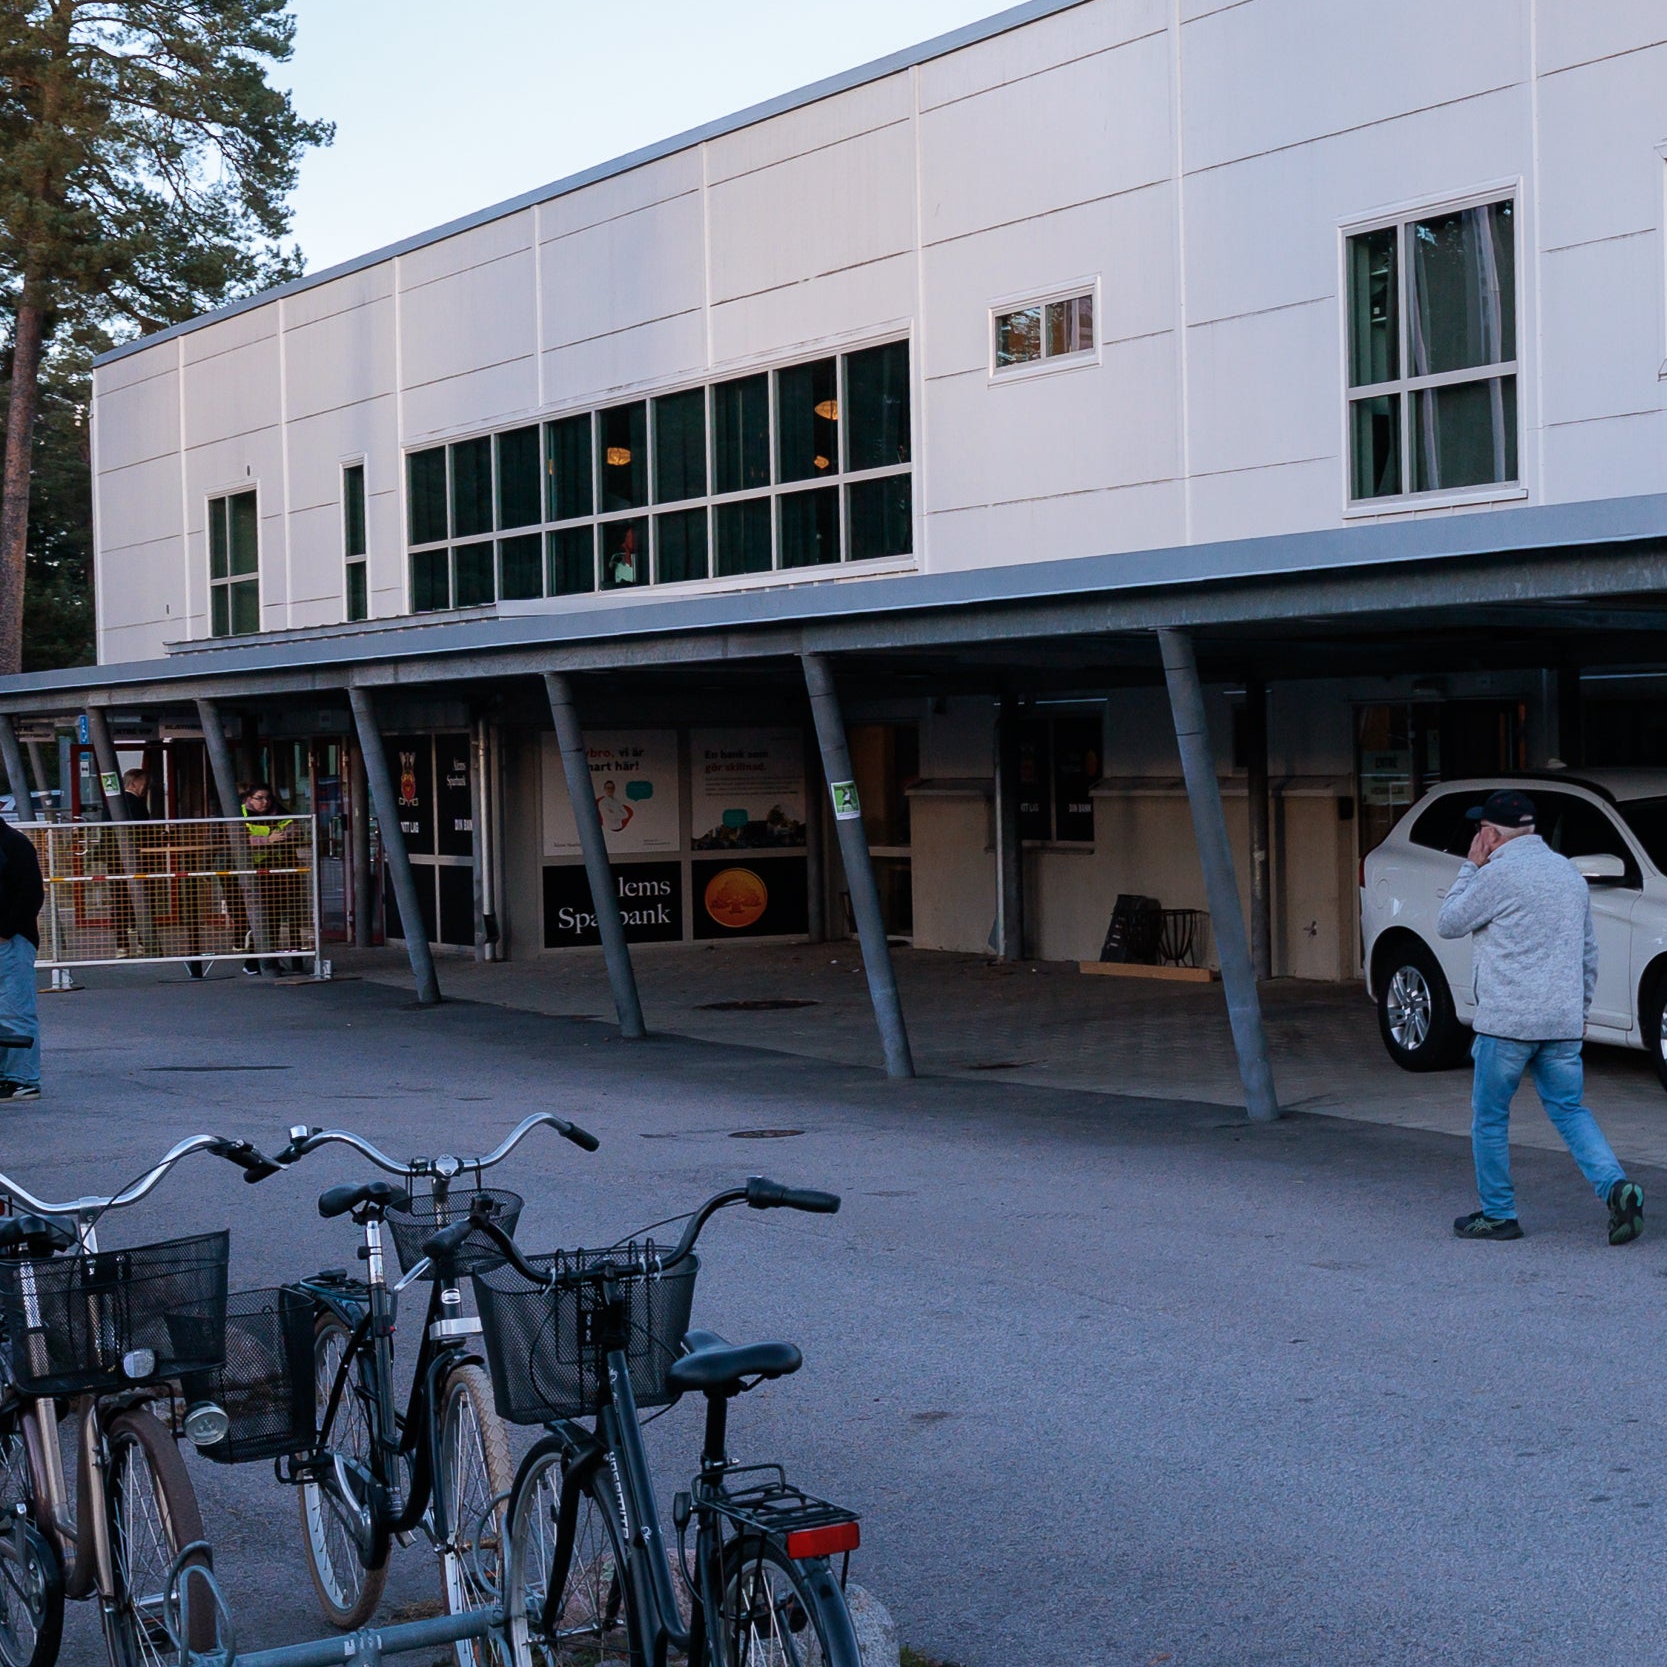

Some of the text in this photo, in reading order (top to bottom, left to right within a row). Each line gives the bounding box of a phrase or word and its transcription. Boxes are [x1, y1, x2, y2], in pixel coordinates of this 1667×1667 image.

[619, 747, 629, 757] vi
[632, 747, 645, 757] är
[704, 749, 718, 759] En
[720, 749, 745, 759] bank
[615, 761, 640, 771] här!
[705, 763, 721, 773] gör
[617, 876, 672, 898] lems
